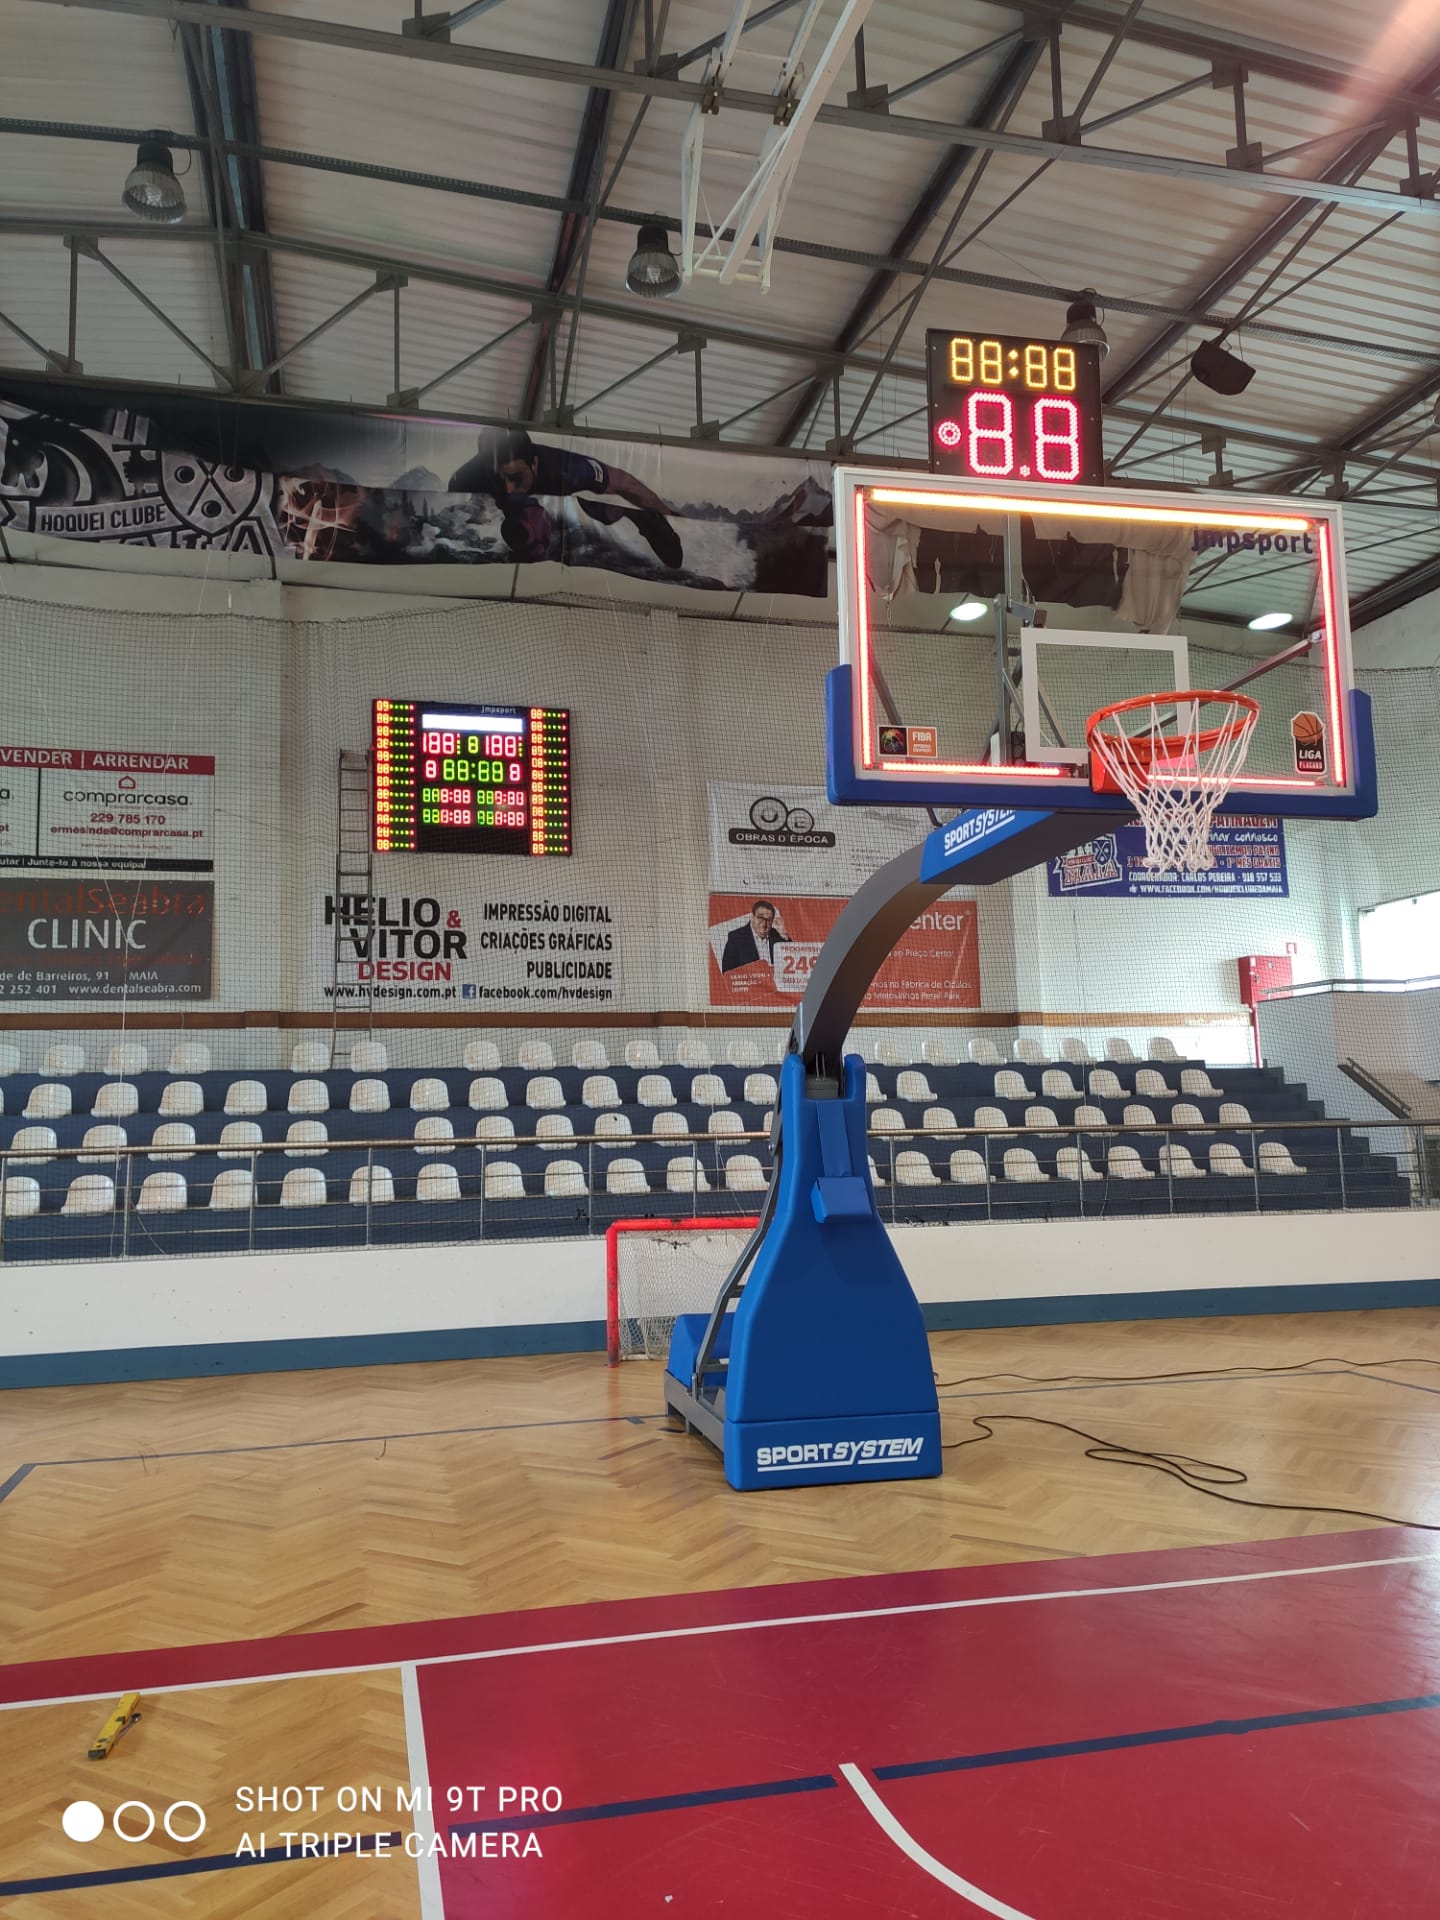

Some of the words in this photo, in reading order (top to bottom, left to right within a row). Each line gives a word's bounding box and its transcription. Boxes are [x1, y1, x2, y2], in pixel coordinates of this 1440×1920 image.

[951, 338, 1076, 391] 88:88
[41, 511, 105, 532] HOQUEI
[111, 504, 167, 530] CLUBE
[912, 731, 932, 742] FIBA
[1, 749, 73, 765] VENDER
[92, 753, 189, 770] ARRENDAR
[1299, 749, 1322, 760] LIGA
[90, 812, 114, 823] 229
[145, 814, 166, 825] 170
[736, 832, 775, 843] OBRAS
[1235, 831, 1278, 842] connosco
[325, 896, 441, 927] HELIO
[447, 909, 461, 928] &
[484, 900, 560, 921] IMPRESSÃO
[563, 905, 612, 922] DIGITAL
[27, 918, 147, 949] CLINIC
[350, 928, 467, 959] VITOR
[480, 928, 546, 954] CRIAÇÕES
[549, 928, 612, 950] GRÁFICAS
[36, 971, 92, 983] Barreiros,
[96, 971, 110, 981] 91
[129, 971, 159, 981] MAIA
[358, 961, 452, 981] DESIGN
[527, 961, 612, 979] PUBLICIDADE
[10, 985, 31, 995] 252
[36, 985, 57, 995] 401
[69, 984, 202, 995] www.dentalseabra.com
[324, 985, 457, 1000] www.hvdesign.com.pt
[479, 986, 613, 1001] facebook.com/hvdesign
[757, 1437, 924, 1466] SPORTSYSTEM
